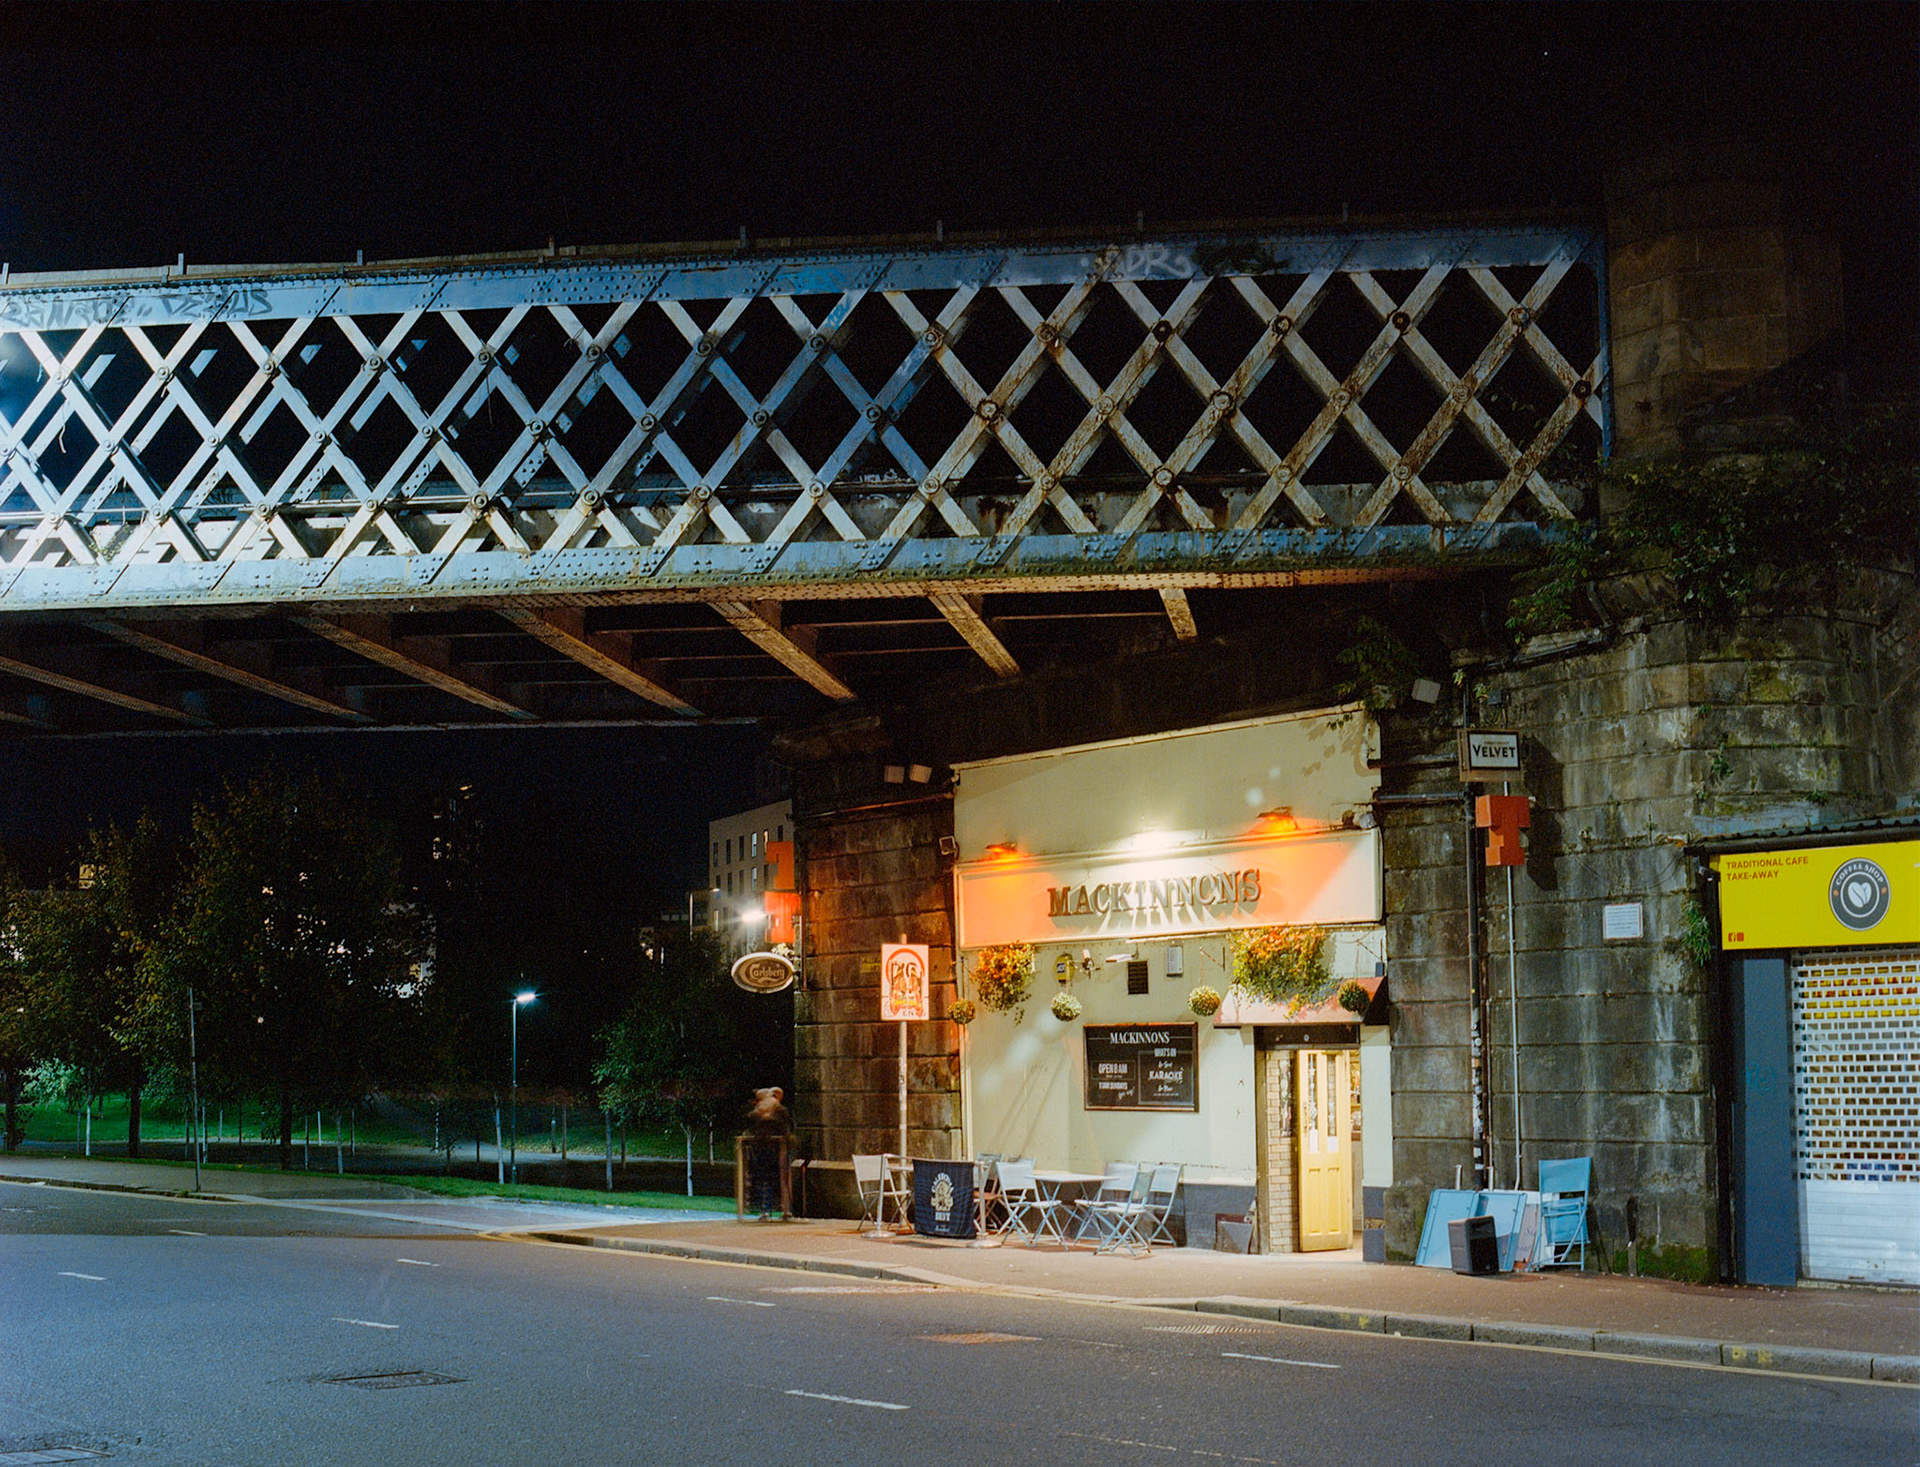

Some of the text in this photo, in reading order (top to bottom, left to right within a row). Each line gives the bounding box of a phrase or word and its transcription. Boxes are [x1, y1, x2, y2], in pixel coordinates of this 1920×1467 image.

[1472, 744, 1516, 758] VELVET
[1726, 856, 1809, 869] TRADITIONAL CAFE
[1726, 870, 1779, 881] TAKE-AWAY
[1835, 863, 1885, 886] COFFEE SHOP
[1047, 868, 1260, 918] MACKINNONS
[749, 963, 785, 980] Carlsberg
[1110, 1032, 1171, 1045] MACKINNONS
[1098, 1063, 1114, 1074] OPEN
[1149, 1070, 1183, 1081] KARAOKE
